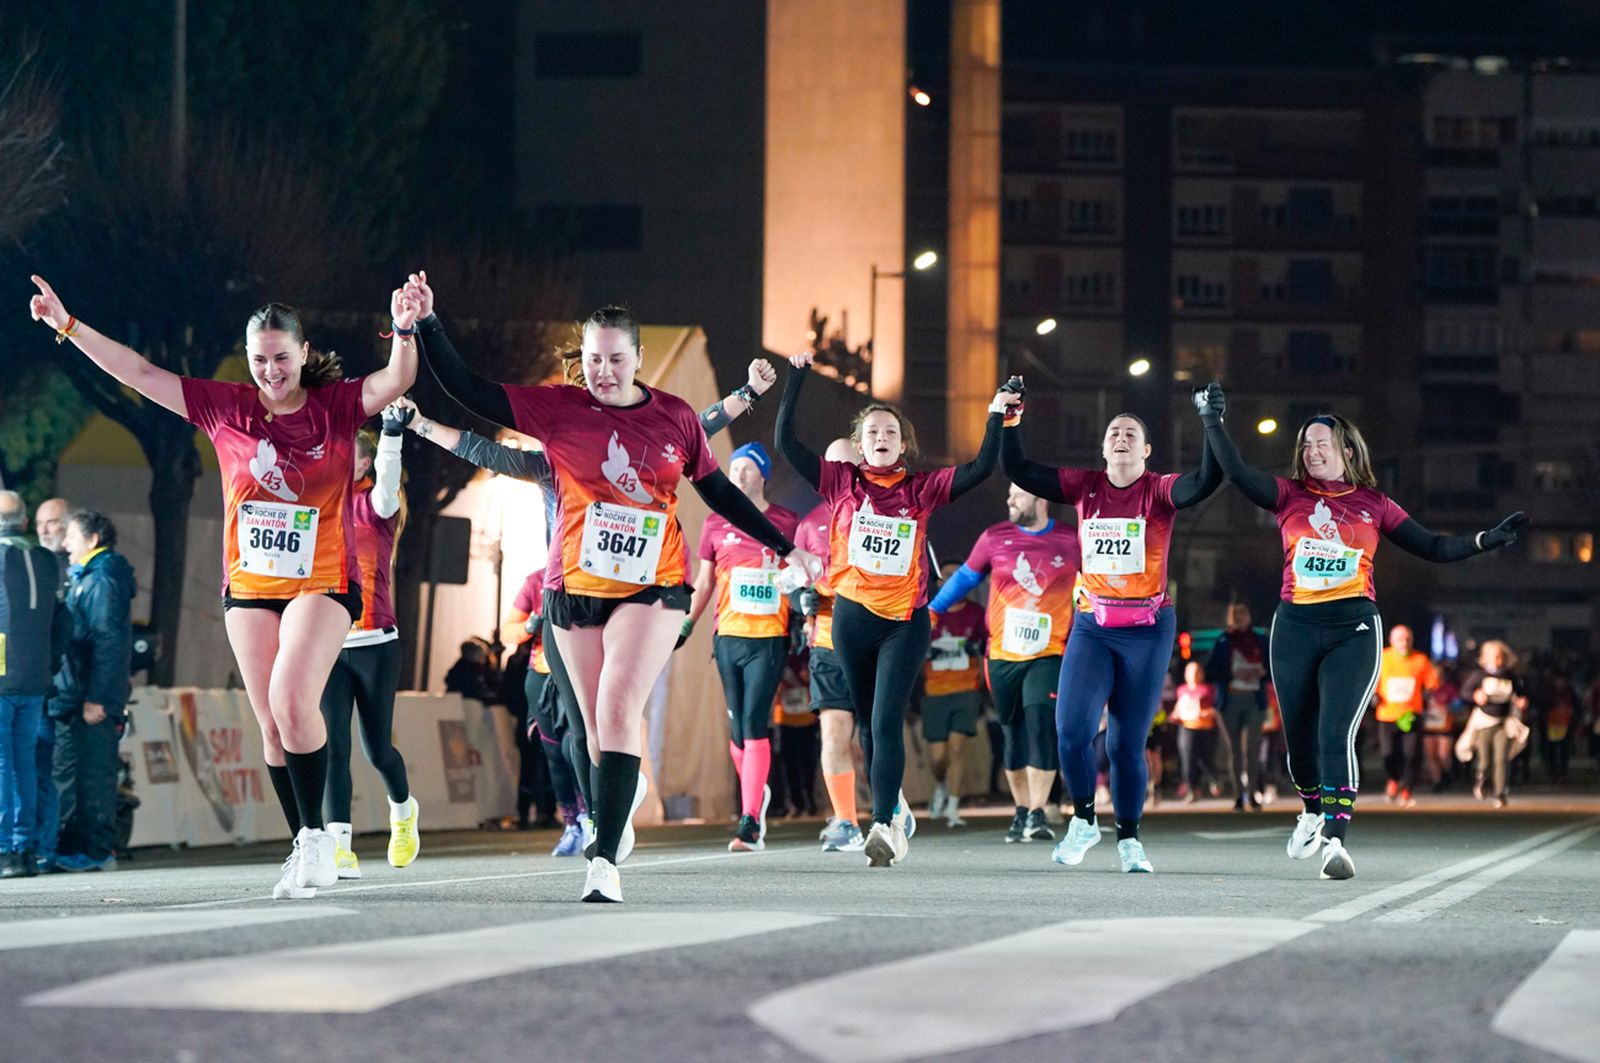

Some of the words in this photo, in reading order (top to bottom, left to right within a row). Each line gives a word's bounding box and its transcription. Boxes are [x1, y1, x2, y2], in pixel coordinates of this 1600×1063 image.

[260, 470, 282, 491] 43
[616, 472, 638, 492] 43
[246, 516, 260, 526] SAN
[278, 510, 287, 519] DE
[604, 512, 626, 523] NOCHE
[627, 516, 637, 524] DE
[593, 519, 610, 529] SAN
[250, 527, 300, 553] 3646
[598, 530, 648, 558] 3647
[862, 535, 900, 556] 4512
[1095, 538, 1131, 555] 2212
[1304, 556, 1346, 572] 4325
[740, 584, 772, 599] 8466
[1014, 626, 1040, 641] 1700
